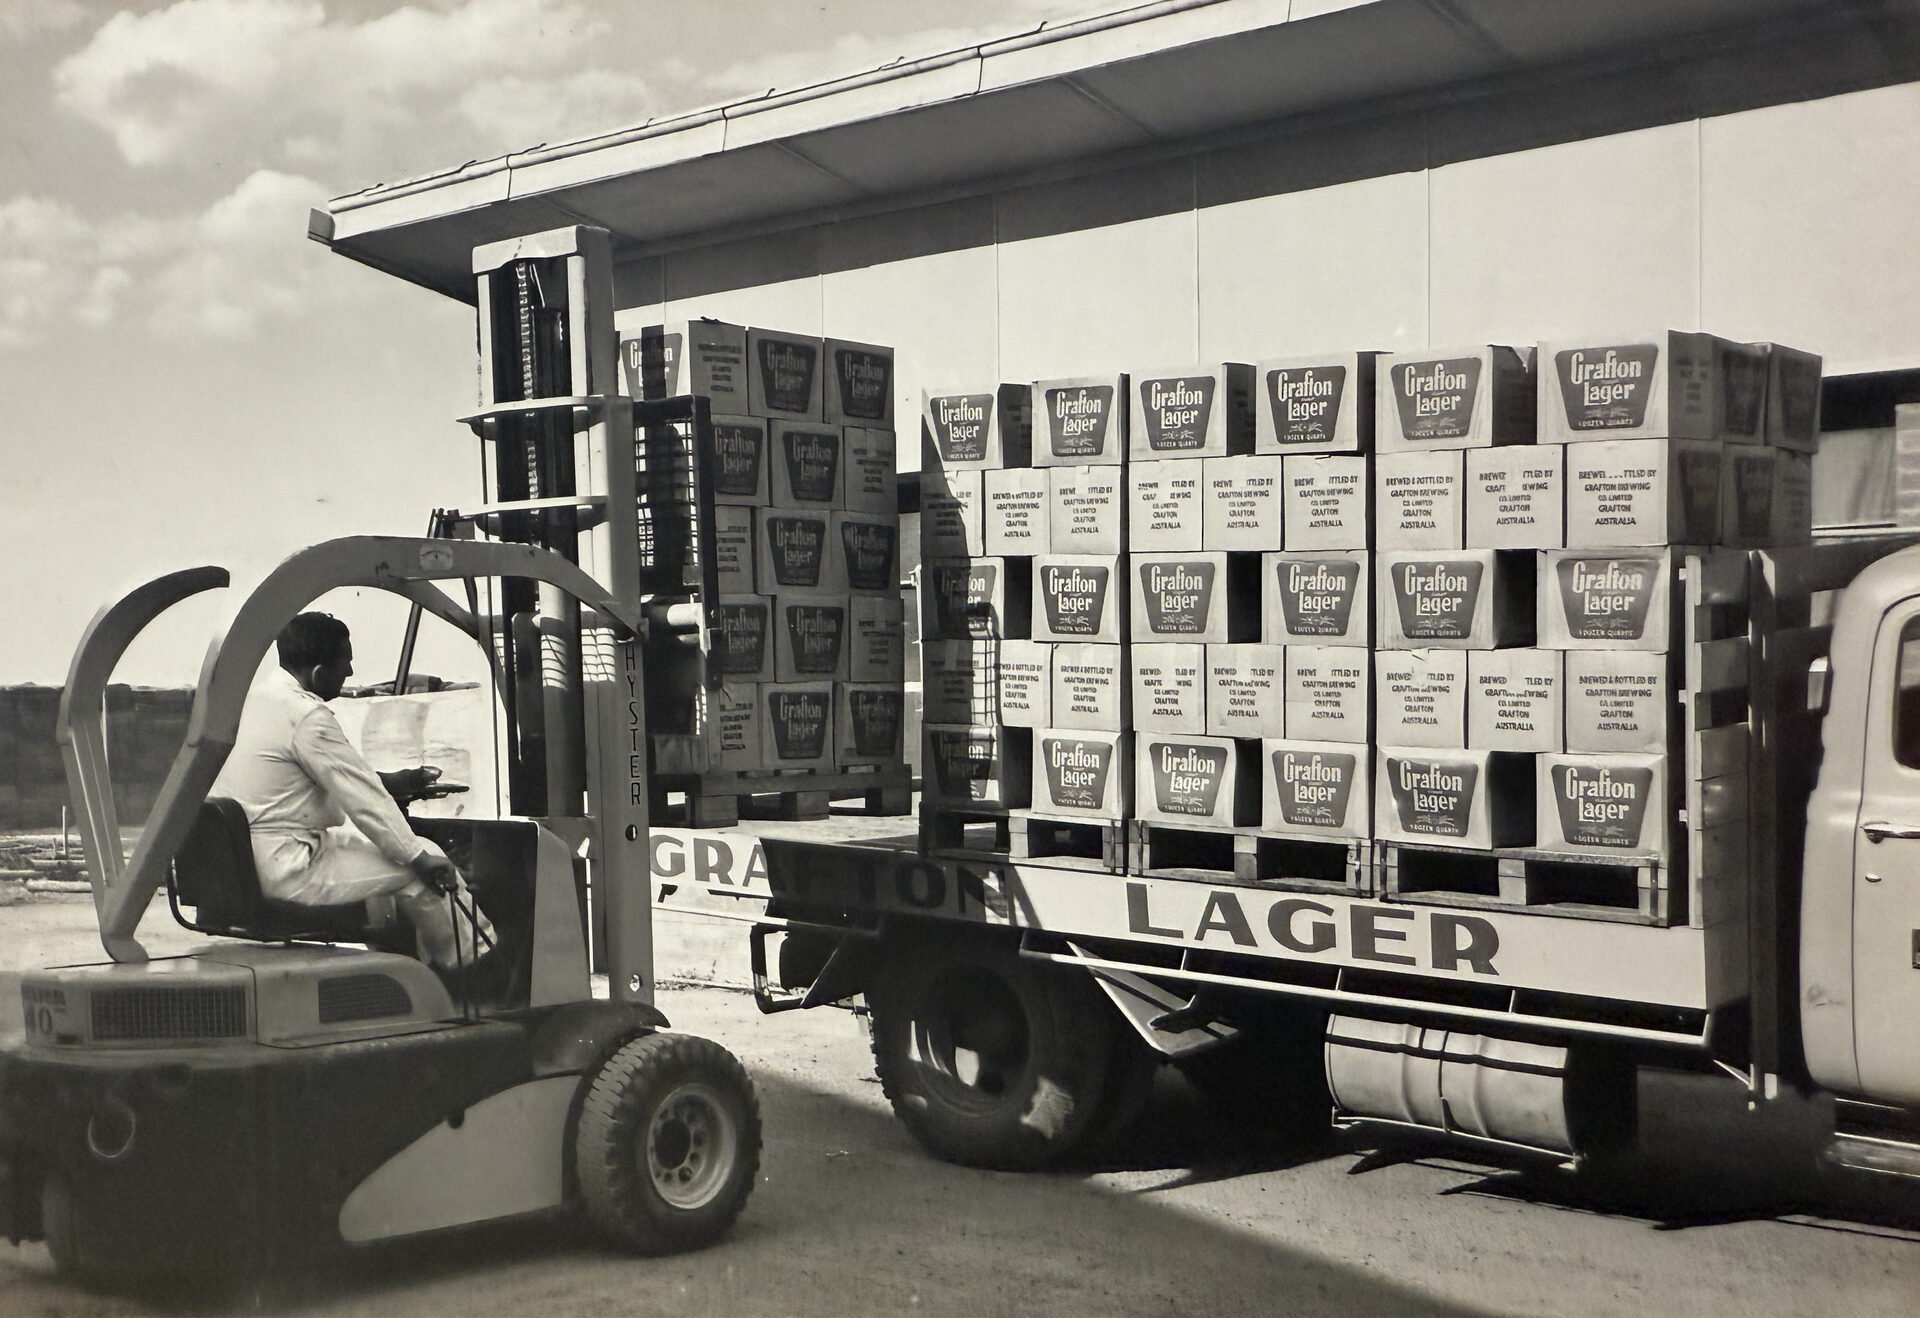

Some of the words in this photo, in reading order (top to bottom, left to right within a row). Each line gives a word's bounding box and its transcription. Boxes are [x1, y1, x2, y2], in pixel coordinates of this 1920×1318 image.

[1404, 363, 1466, 397] Grafton
[1571, 351, 1641, 385] Grafton
[1151, 380, 1203, 411] Grafton
[1278, 370, 1332, 402] Grafton
[1583, 382, 1635, 406] Lager
[940, 398, 983, 425] Grafton
[1056, 390, 1102, 418] Grafton
[1287, 399, 1327, 421] Lager
[1415, 393, 1461, 416] Lager
[1063, 416, 1097, 436] Lager
[1161, 407, 1199, 429] Lager
[950, 422, 979, 442] Lager
[1294, 478, 1314, 487] BREWE
[1479, 472, 1506, 480] BREWE
[1400, 521, 1436, 529] AUSTRALIA
[1595, 517, 1637, 525] AUSTRALIA
[1050, 568, 1096, 595] Grafton
[1151, 565, 1203, 593] Grafton
[1289, 564, 1346, 593] Grafton
[1404, 564, 1468, 595] Grafton
[1572, 561, 1642, 593] Grafton
[1058, 593, 1093, 613] Lager
[1161, 590, 1199, 613] Lager
[1299, 590, 1341, 614] Lager
[1416, 591, 1462, 616] Lager
[1584, 590, 1635, 615] Lager
[1297, 669, 1317, 677] BREWE
[625, 646, 641, 806] HYSTER
[1495, 722, 1534, 731] AUSTRALIA
[1052, 741, 1100, 769] Grafton
[1162, 745, 1216, 774] Grafton
[1061, 766, 1096, 788] Lager
[1283, 753, 1342, 783] Grafton
[1400, 760, 1462, 792] Grafton
[1170, 771, 1210, 794] Lager
[1294, 780, 1336, 804] Lager
[1565, 767, 1636, 800] Grafton
[1413, 788, 1458, 812] Lager
[1578, 797, 1630, 822] Lager
[1126, 882, 1500, 976] LAGER
